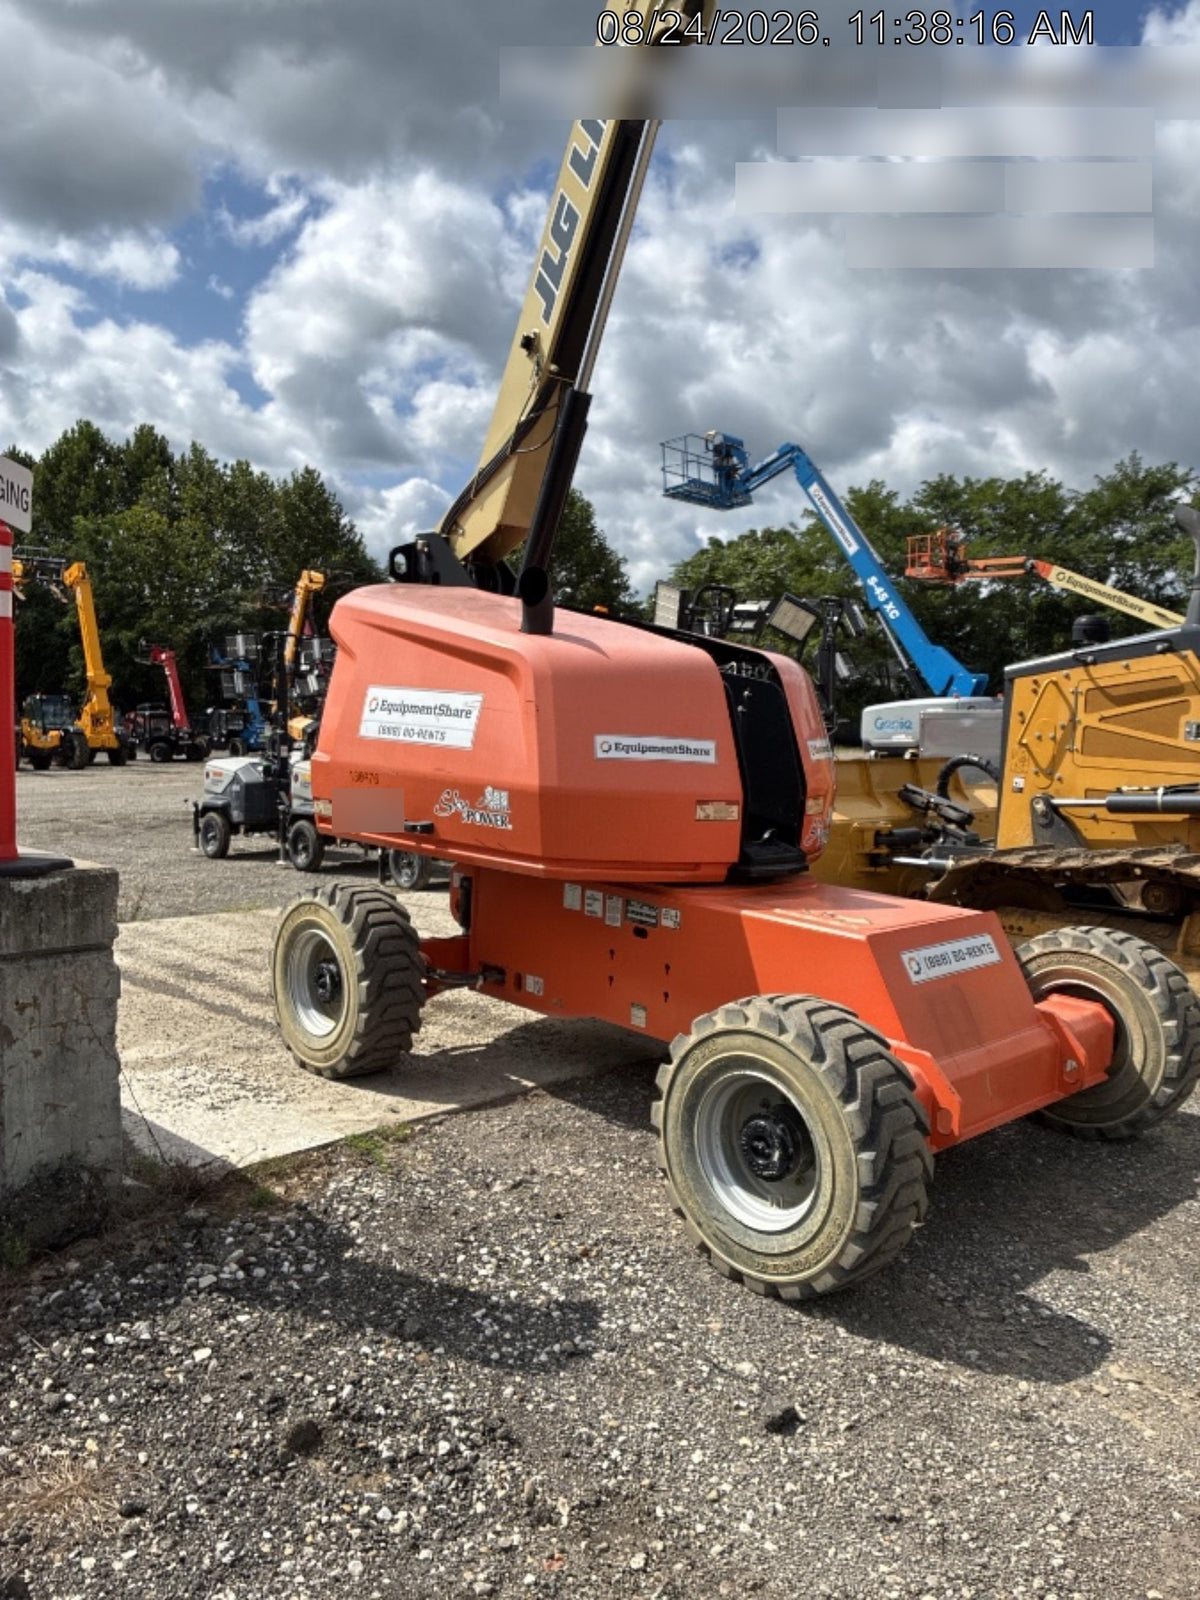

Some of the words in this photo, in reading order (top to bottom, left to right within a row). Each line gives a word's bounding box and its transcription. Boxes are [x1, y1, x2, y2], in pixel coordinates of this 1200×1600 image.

[533, 188, 581, 328] JLG
[867, 575, 889, 602] S-45
[883, 601, 900, 620] XC
[1066, 575, 1145, 613] EquipmentShare
[380, 699, 473, 719] EquipmentShare
[614, 741, 711, 756] EquipmentShare
